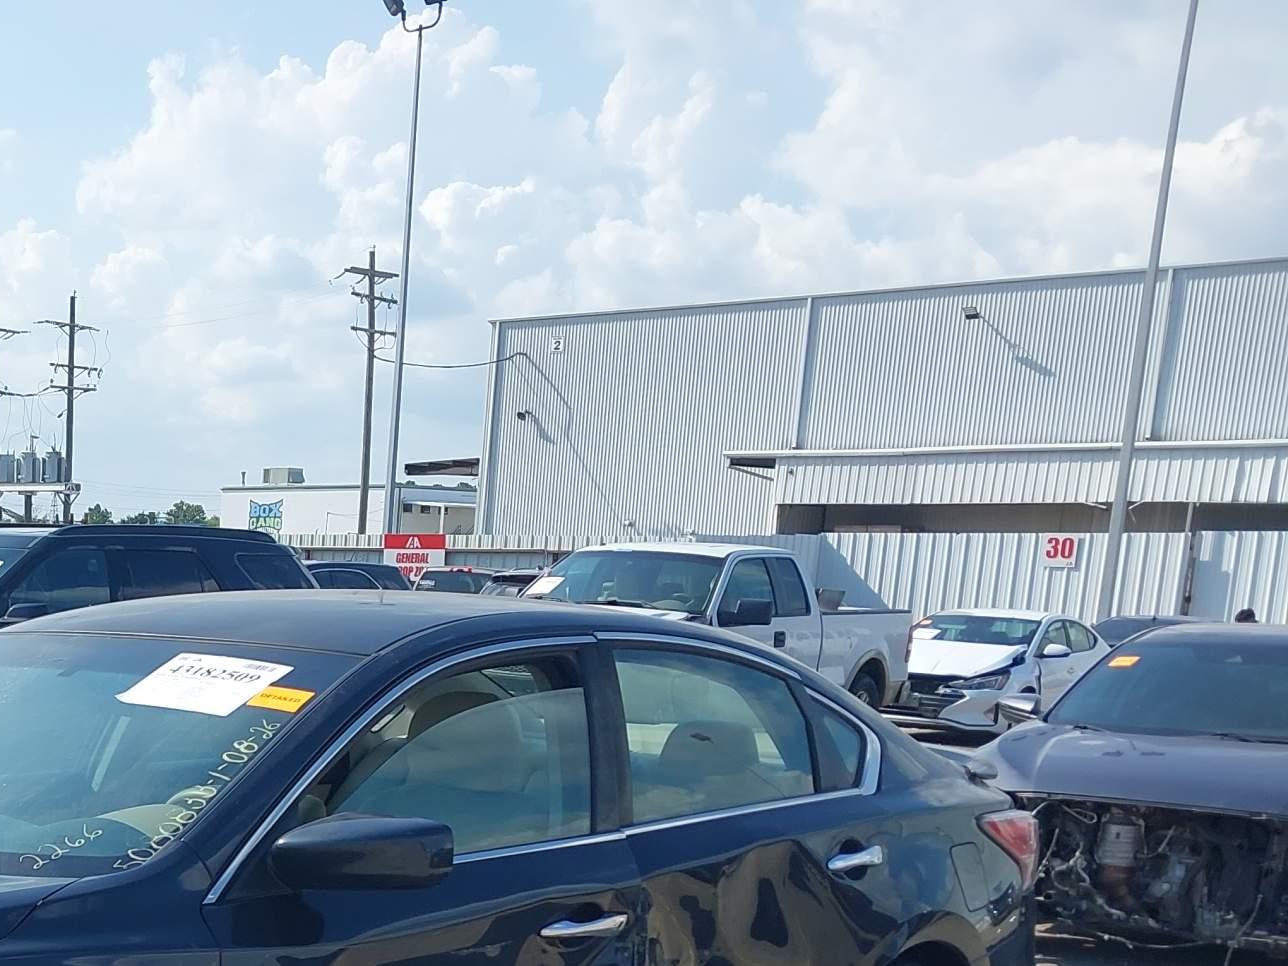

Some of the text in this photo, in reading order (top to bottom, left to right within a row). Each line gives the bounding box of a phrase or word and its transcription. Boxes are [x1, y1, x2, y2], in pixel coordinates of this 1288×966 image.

[553, 340, 561, 350] 2
[251, 502, 281, 517] BOX
[1046, 537, 1074, 559] 30
[395, 552, 429, 564] GENERAL
[169, 664, 261, 684] 43182509
[19, 823, 103, 870] 2266
